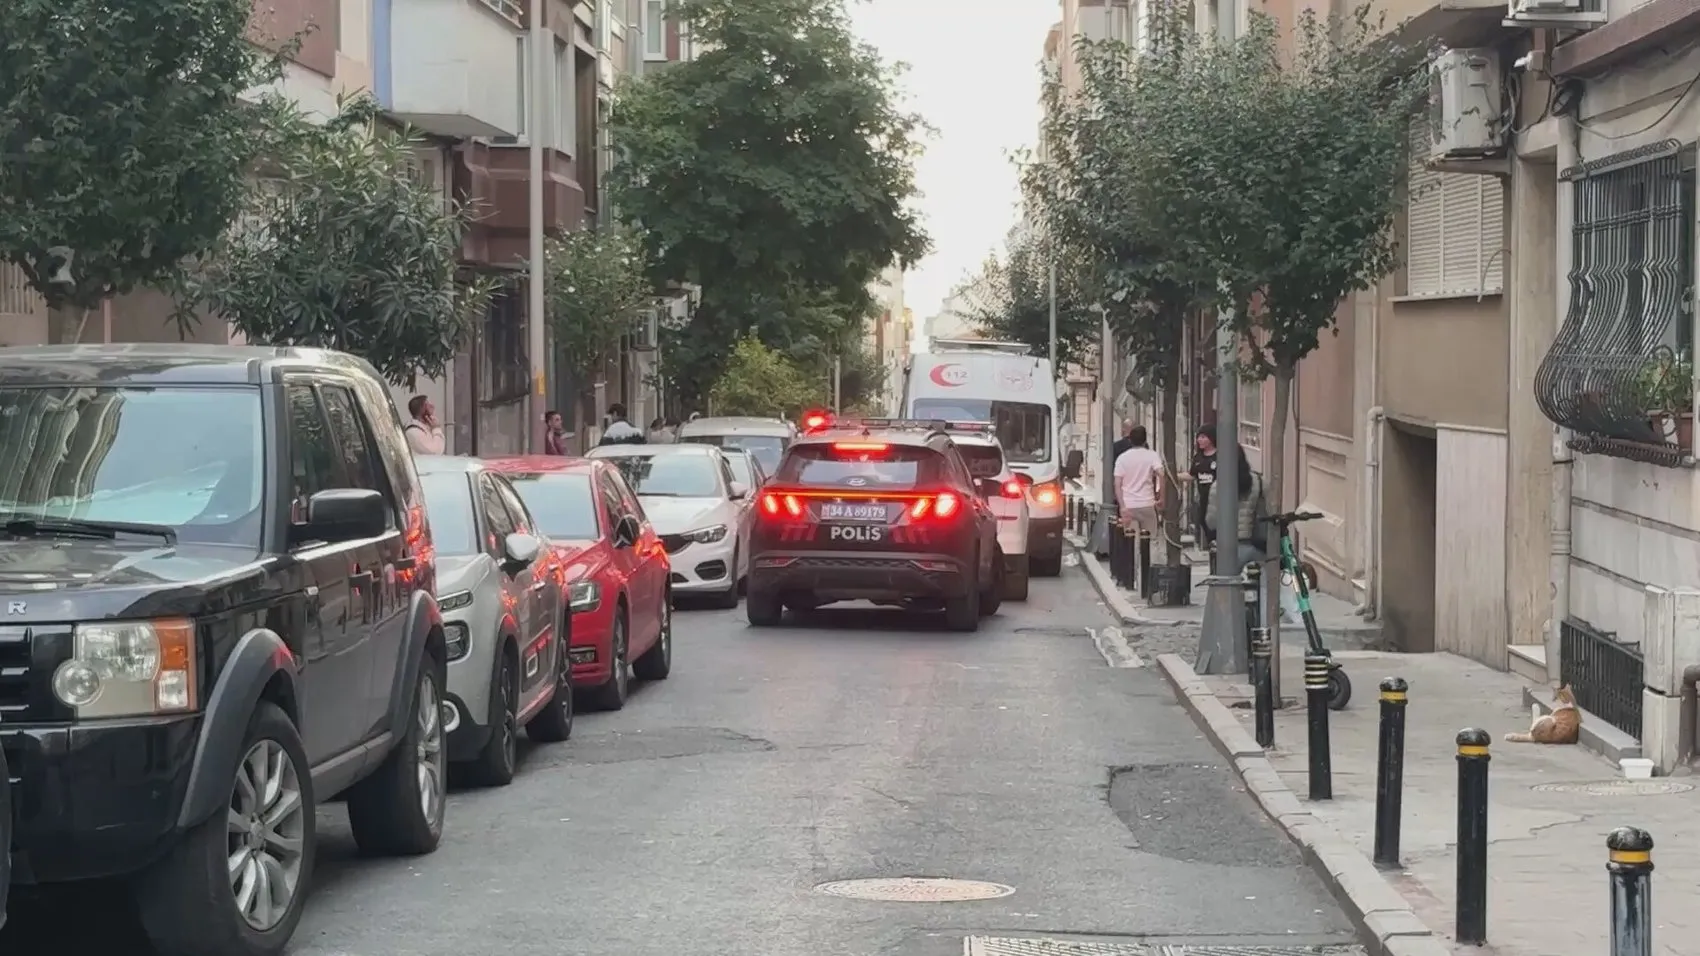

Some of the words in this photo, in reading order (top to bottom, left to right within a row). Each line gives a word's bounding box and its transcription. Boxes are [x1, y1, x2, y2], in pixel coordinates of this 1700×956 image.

[946, 371, 968, 379] 112
[830, 505, 843, 517] 34
[844, 506, 853, 517] A
[854, 506, 886, 518] 89179
[8, 600, 27, 615] R
